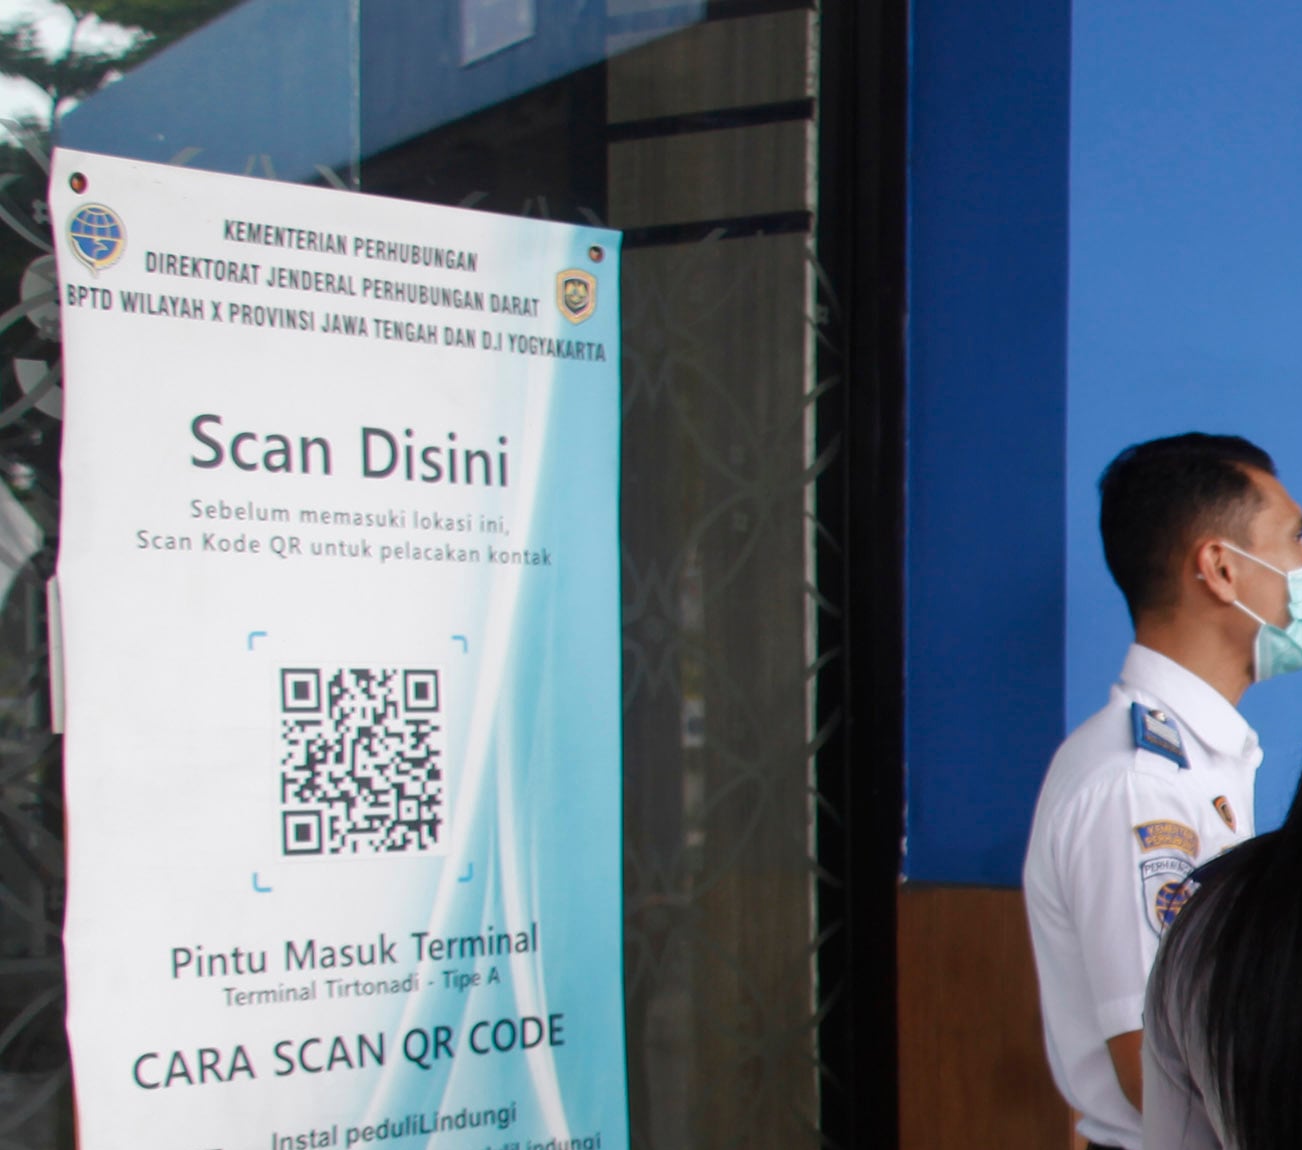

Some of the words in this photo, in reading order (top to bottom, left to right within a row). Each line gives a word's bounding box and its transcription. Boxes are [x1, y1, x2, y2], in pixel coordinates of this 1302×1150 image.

[224, 219, 348, 256] KEMENTERIAN
[354, 236, 478, 273] PERHUBUNGAN
[145, 251, 261, 286] DIREKTORAT
[266, 266, 357, 298] JENDERAL
[362, 277, 485, 312] PERHUBUNGAN
[490, 293, 540, 318] DARAT
[66, 284, 113, 310] BPTD
[120, 291, 204, 321] WILAYAH
[211, 301, 223, 322] X
[229, 303, 315, 332] PROVINSI
[321, 313, 368, 338] JAWA
[374, 318, 438, 345] TENGAH
[444, 326, 476, 349] DAN
[508, 334, 607, 362] YOGYAKARTA
[191, 413, 334, 476] Scan
[361, 426, 509, 488] Disini
[190, 500, 291, 523] Sebelum
[300, 506, 406, 529] memasuki
[413, 511, 472, 532] lokasi
[480, 516, 511, 537] ini,
[137, 530, 192, 551] Scan
[203, 532, 260, 554] Kode
[270, 536, 302, 560] QR
[310, 537, 374, 559] untuk
[380, 541, 480, 564] pelacakan
[488, 543, 552, 567] kontak
[172, 943, 269, 980] Pintu
[284, 933, 398, 972] Masuk
[411, 922, 539, 962] Terminal
[222, 980, 317, 1008] Terminal
[326, 972, 419, 999] Tirtonadi
[442, 969, 482, 992] Tipe
[487, 967, 501, 987] A
[133, 1042, 257, 1091] CARA
[274, 1031, 386, 1079] SCAN
[402, 1025, 455, 1071] QR
[469, 1013, 566, 1055] CODE
[346, 1102, 517, 1149] peduliLindungi
